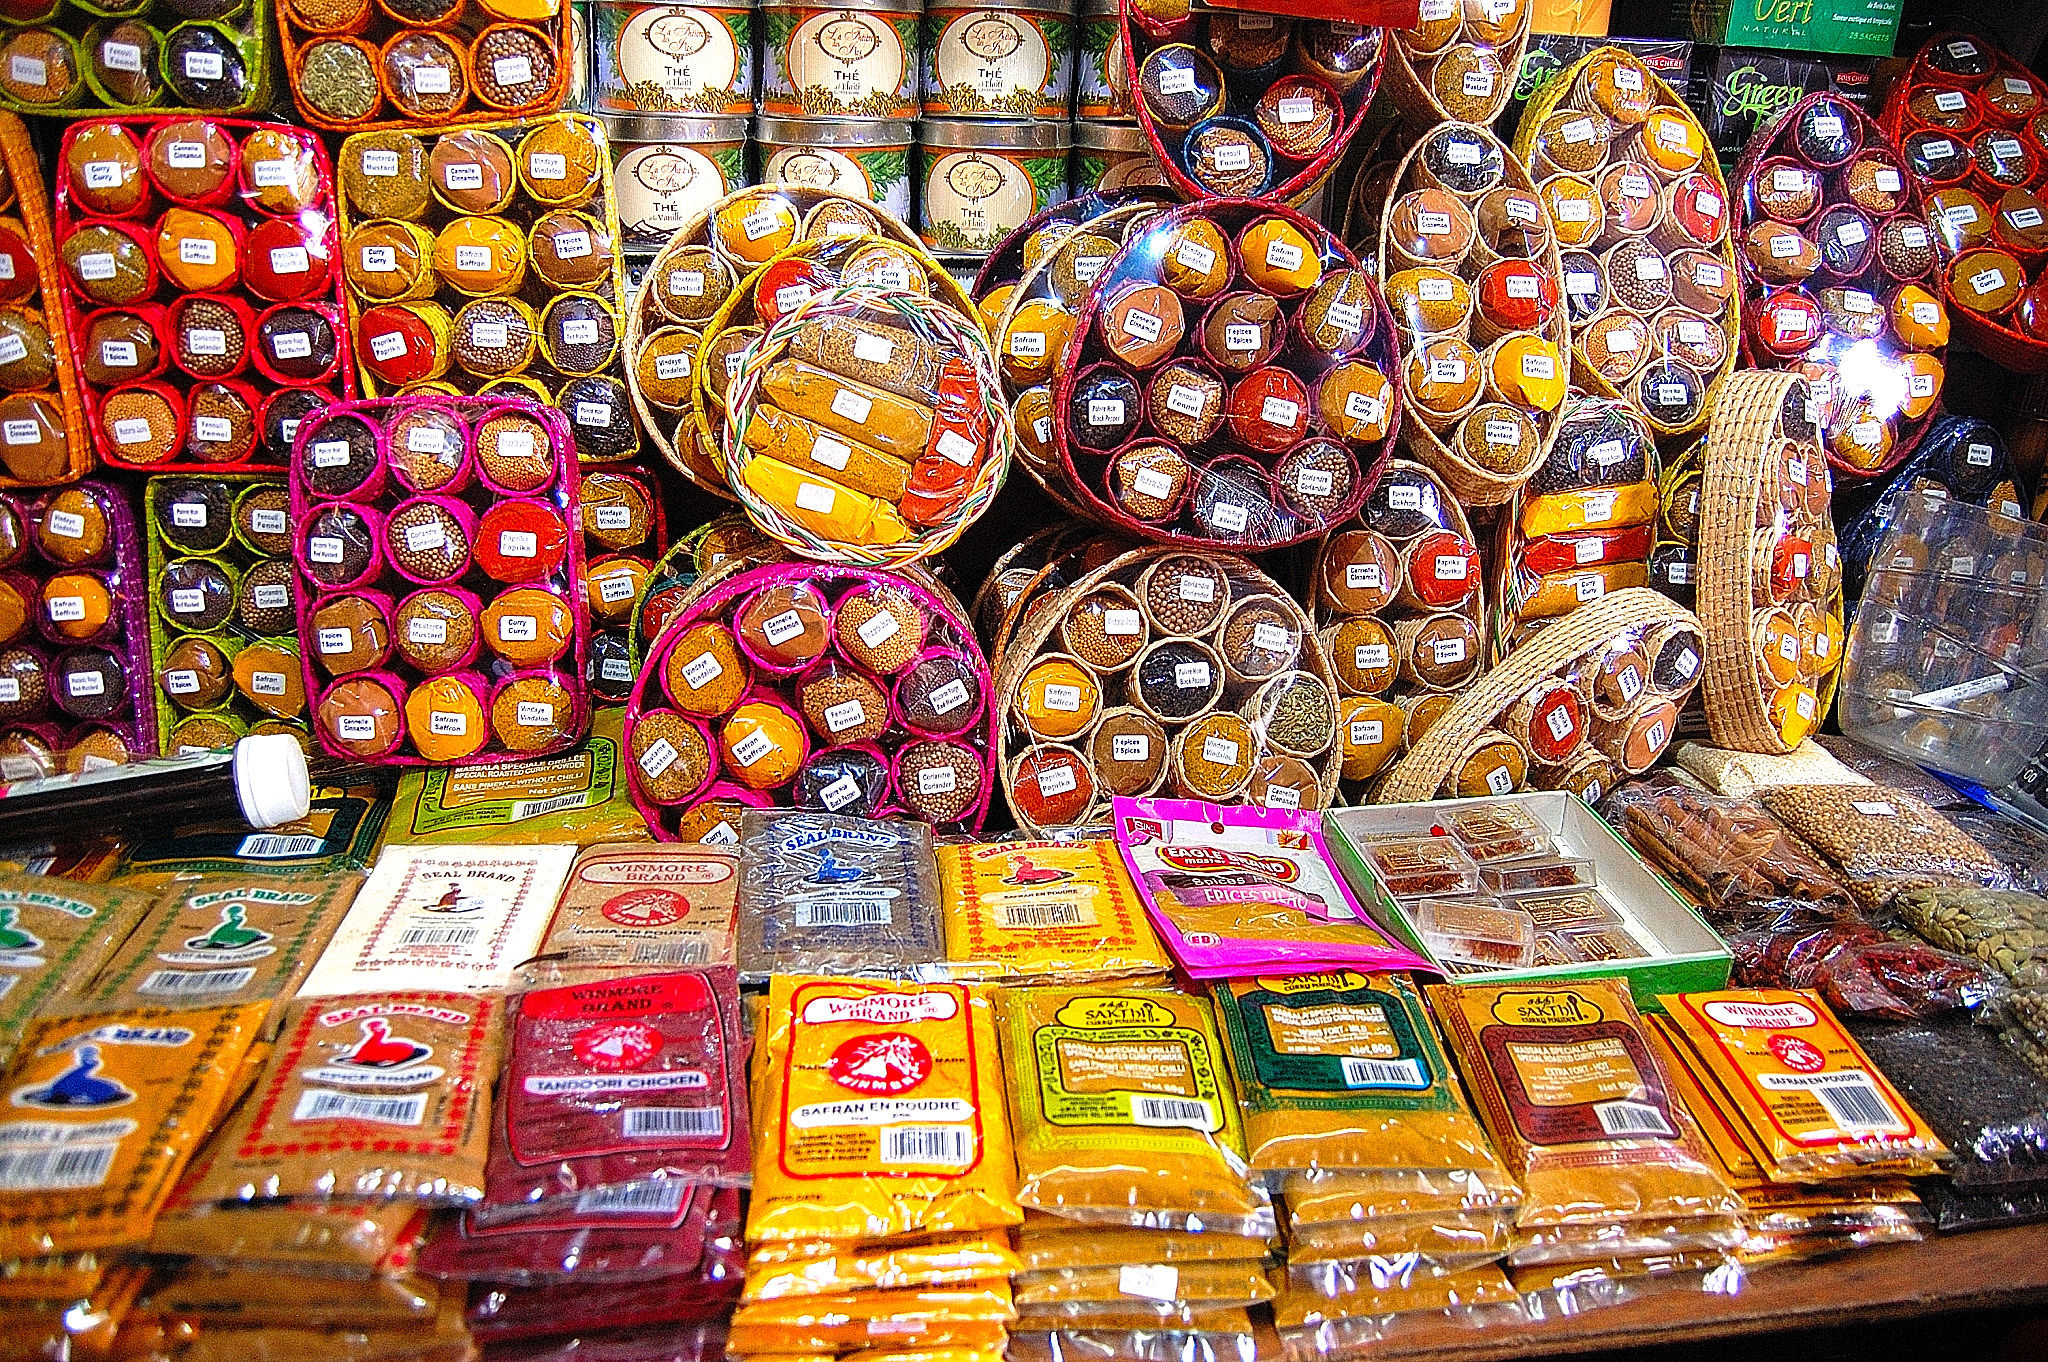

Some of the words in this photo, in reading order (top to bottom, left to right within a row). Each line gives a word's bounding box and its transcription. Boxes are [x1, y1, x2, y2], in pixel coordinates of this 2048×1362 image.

[664, 65, 690, 76] THÉ
[834, 69, 859, 80] THÉ
[978, 67, 1002, 79] THÉ
[1723, 68, 1802, 121] Green
[653, 202, 678, 212] THÉ
[881, 278, 900, 286] Curry
[1014, 345, 1040, 353] Saffron
[1438, 369, 1457, 377] Curry
[1355, 397, 1373, 406] Curry
[1353, 405, 1372, 416] Curry
[257, 522, 282, 530] Fennel
[1438, 567, 1462, 575] Paprika
[603, 582, 626, 590] Safran
[605, 589, 630, 598] Saffron
[255, 684, 280, 692] Saffron
[435, 715, 459, 724] Safran
[834, 715, 861, 727] Fennel
[435, 723, 461, 732] Saffron
[737, 737, 758, 754] Safran
[742, 744, 768, 760] Saffron
[1043, 780, 1071, 791] Paprika
[785, 832, 828, 850] SEAL
[977, 843, 1017, 859] SEAL
[1026, 841, 1088, 849] BRAND
[1169, 847, 1224, 859] EAGLE
[608, 864, 707, 872] WINMORE
[467, 870, 516, 883] BRAND
[626, 873, 686, 881] BRAND
[582, 999, 651, 1012] BRAND
[1723, 1005, 1798, 1016] WINMORE
[850, 1009, 910, 1020] BRAND
[1746, 1016, 1790, 1028] BRAND
[1550, 1044, 1588, 1055] SPECIALE
[1544, 1066, 1566, 1075] EXTRA
[1566, 1065, 1589, 1074] FORT
[1595, 1062, 1610, 1071] HOT
[537, 1079, 622, 1091] TANDOORI
[627, 1074, 700, 1088] CHICKEN
[1769, 1075, 1808, 1085] SAFRAN
[1809, 1077, 1820, 1085] EN
[1821, 1074, 1863, 1084] POUDRE
[801, 1101, 865, 1117] SAFRAN
[870, 1102, 890, 1111] EN
[895, 1101, 961, 1111] POUDRE
